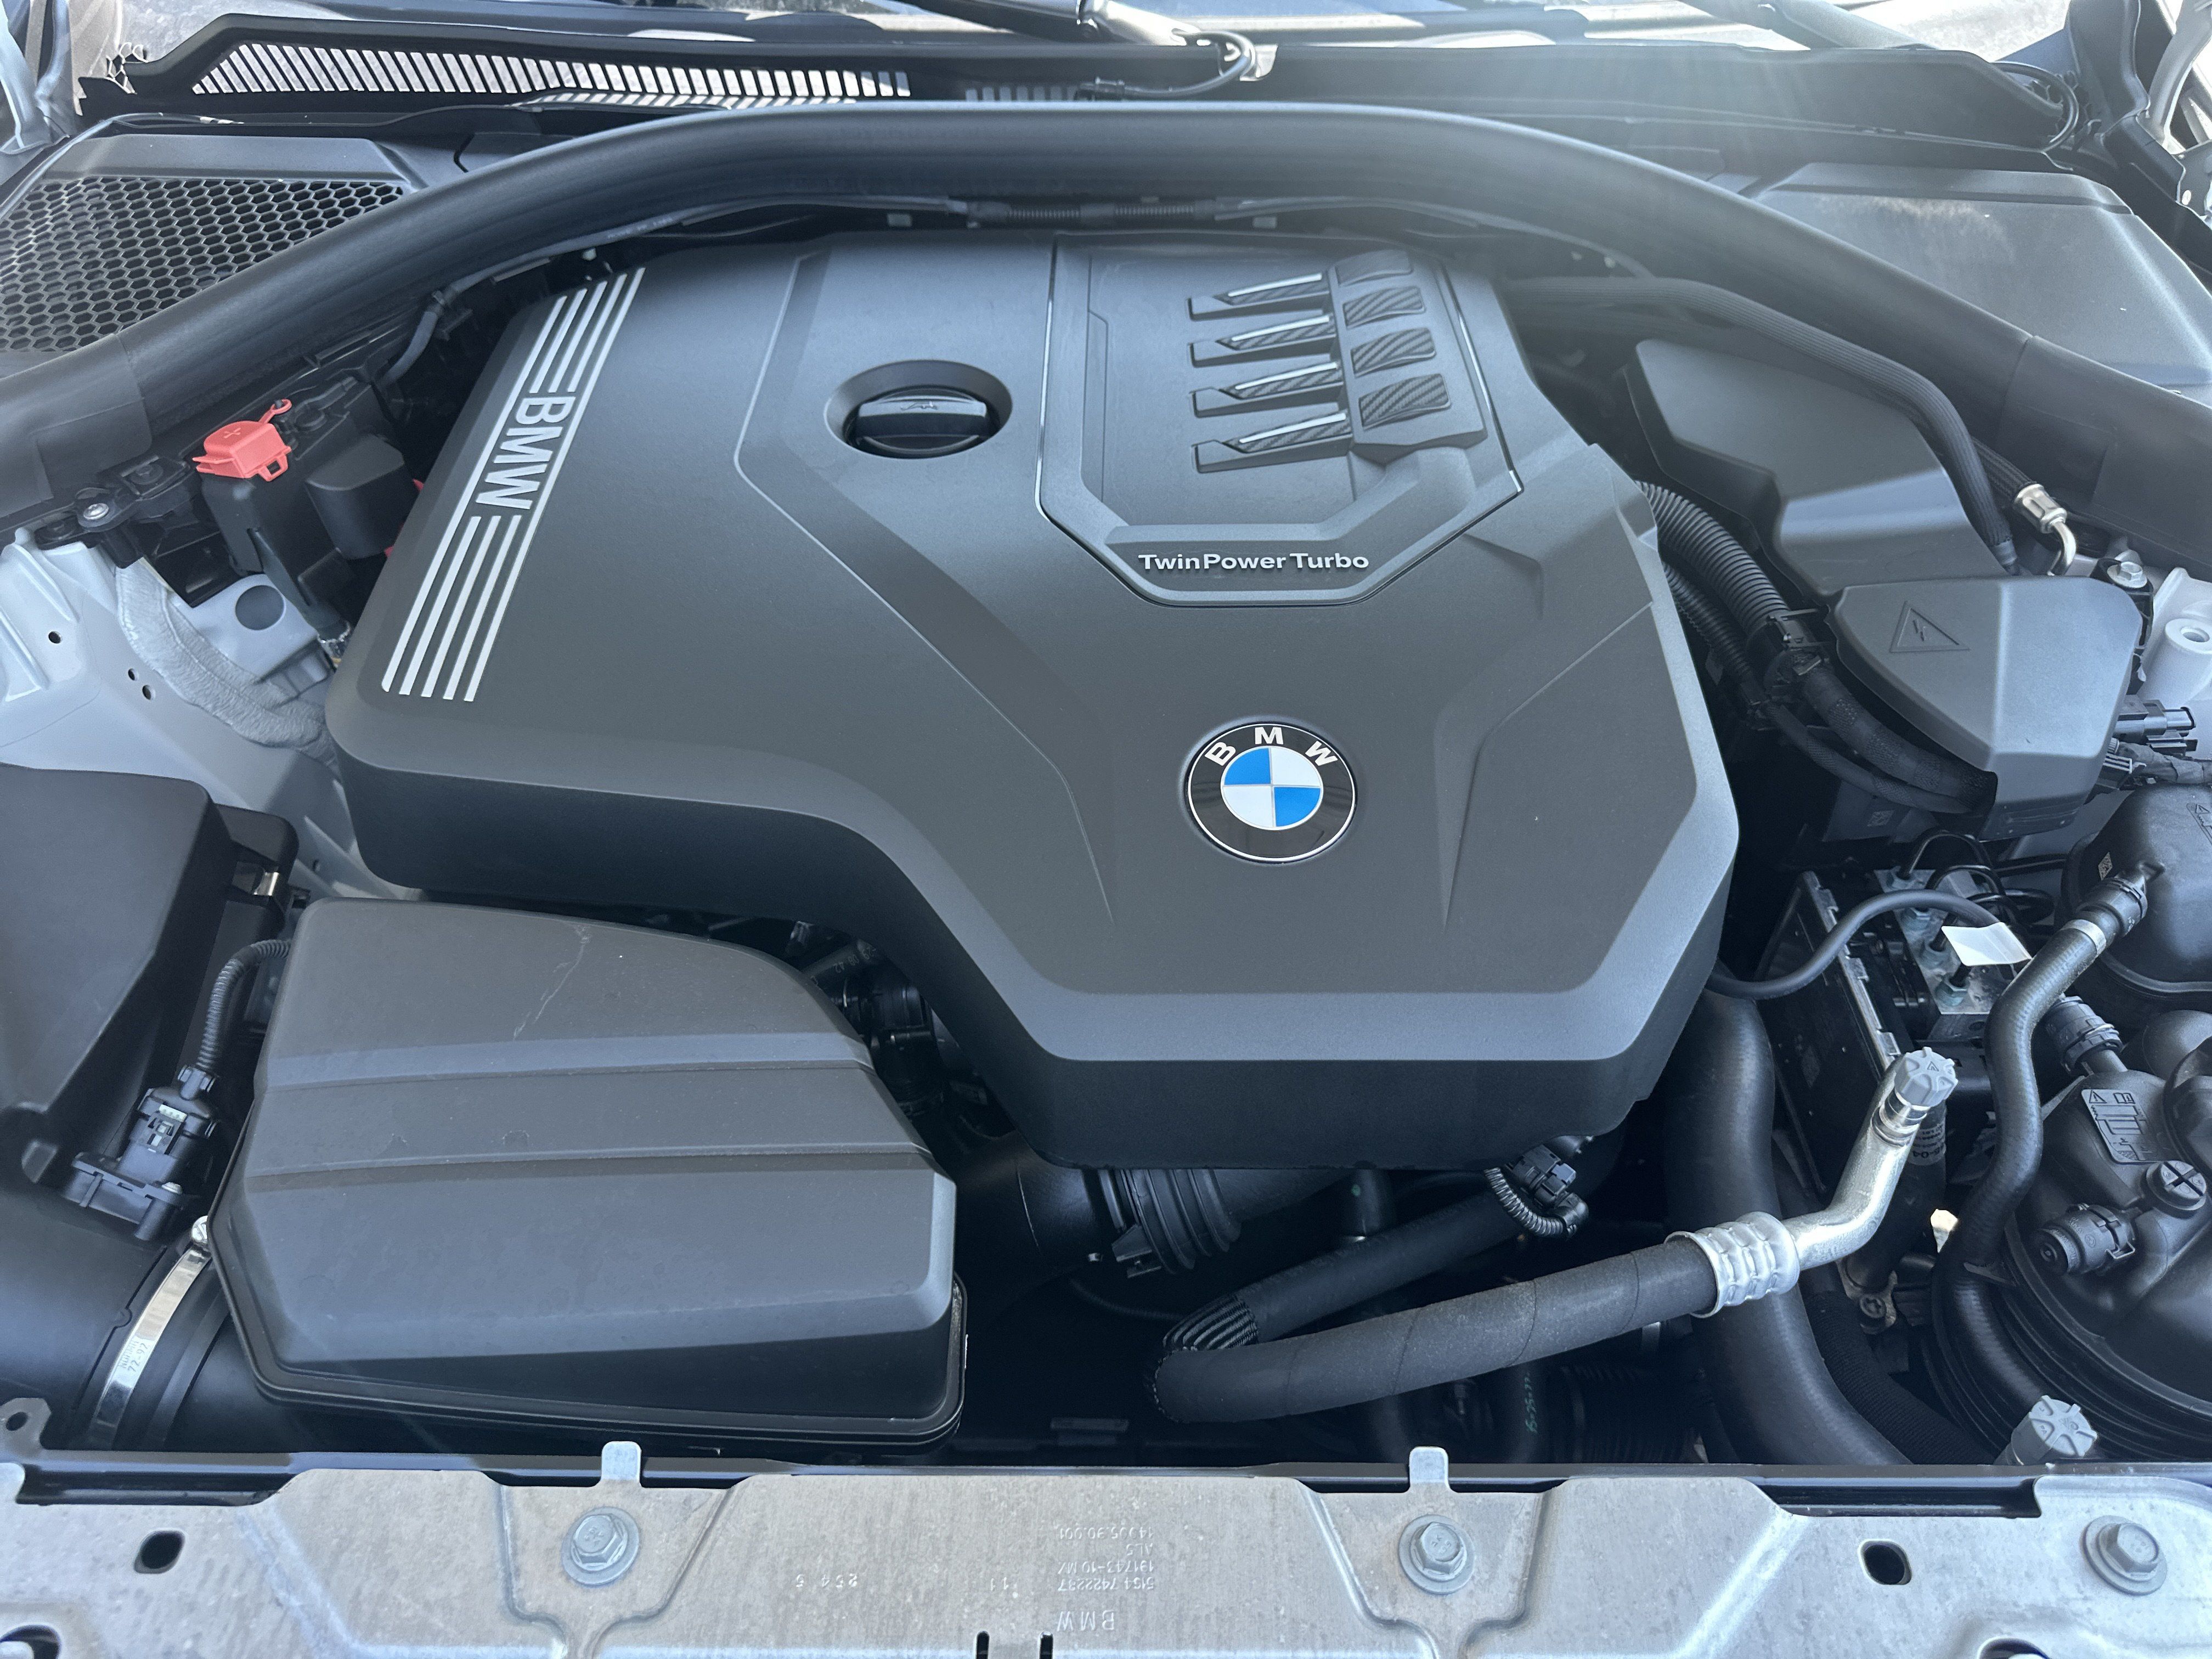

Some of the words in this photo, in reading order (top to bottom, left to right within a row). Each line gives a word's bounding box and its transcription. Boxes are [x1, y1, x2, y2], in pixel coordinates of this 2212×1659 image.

[475, 396, 576, 510] BMW
[1138, 553, 1286, 569] TwinPower
[1289, 552, 1369, 568] Turbo
[1205, 727, 1338, 766] BMW
[1057, 1610, 1115, 1632] BMW
